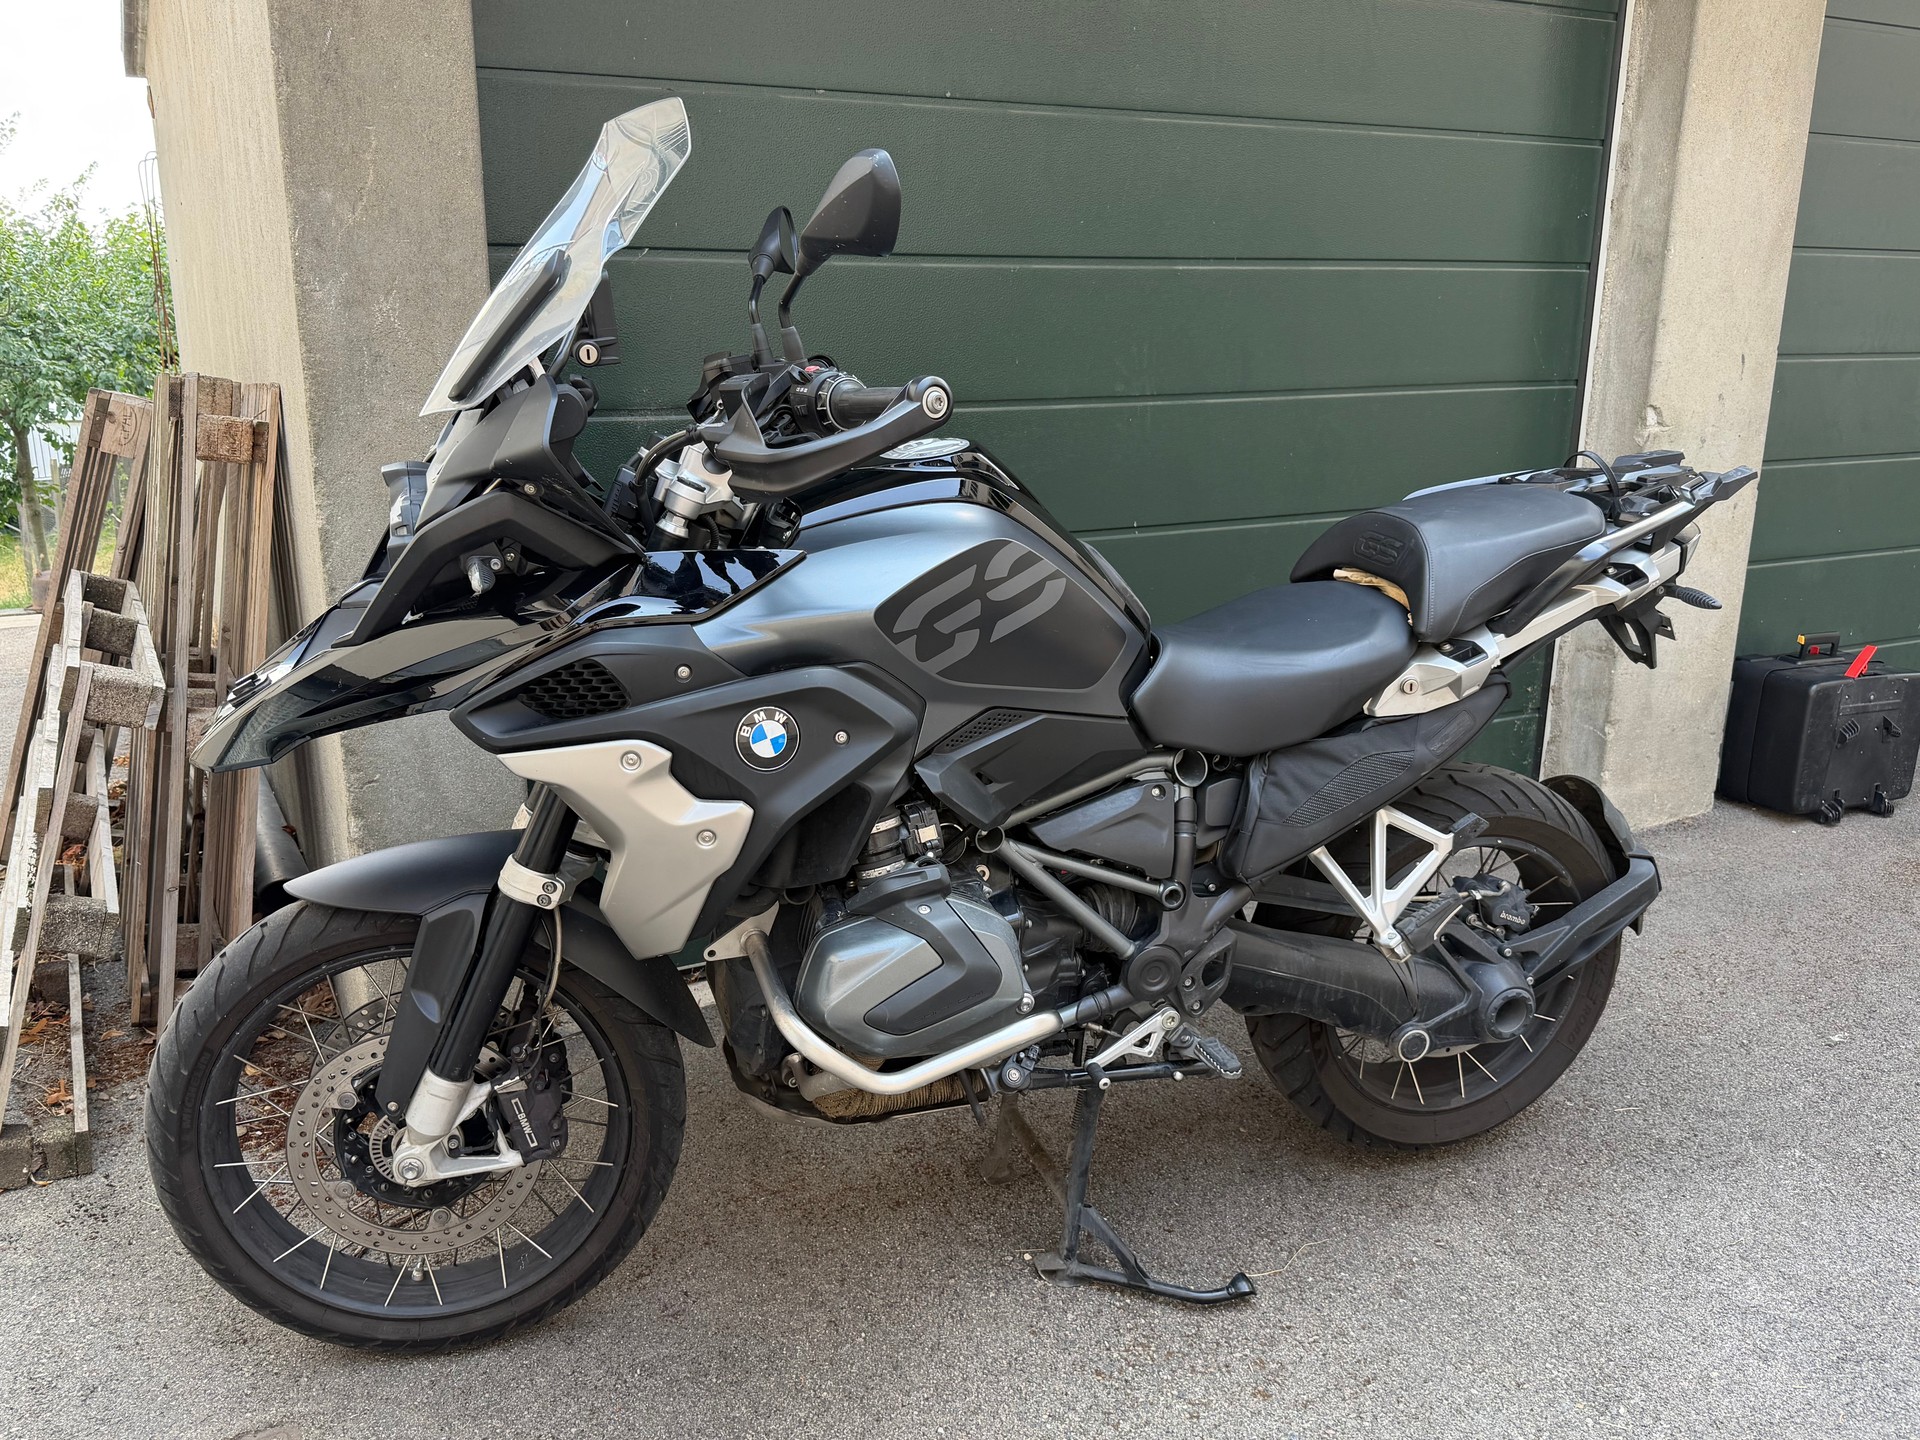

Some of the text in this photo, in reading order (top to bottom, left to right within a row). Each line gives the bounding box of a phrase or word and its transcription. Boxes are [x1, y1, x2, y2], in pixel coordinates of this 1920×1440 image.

[892, 541, 1067, 674] GS
[740, 710, 788, 737] BMW
[1500, 910, 1526, 925] brembo
[181, 1050, 211, 1129] MICHELIN
[517, 1113, 533, 1134] BMW
